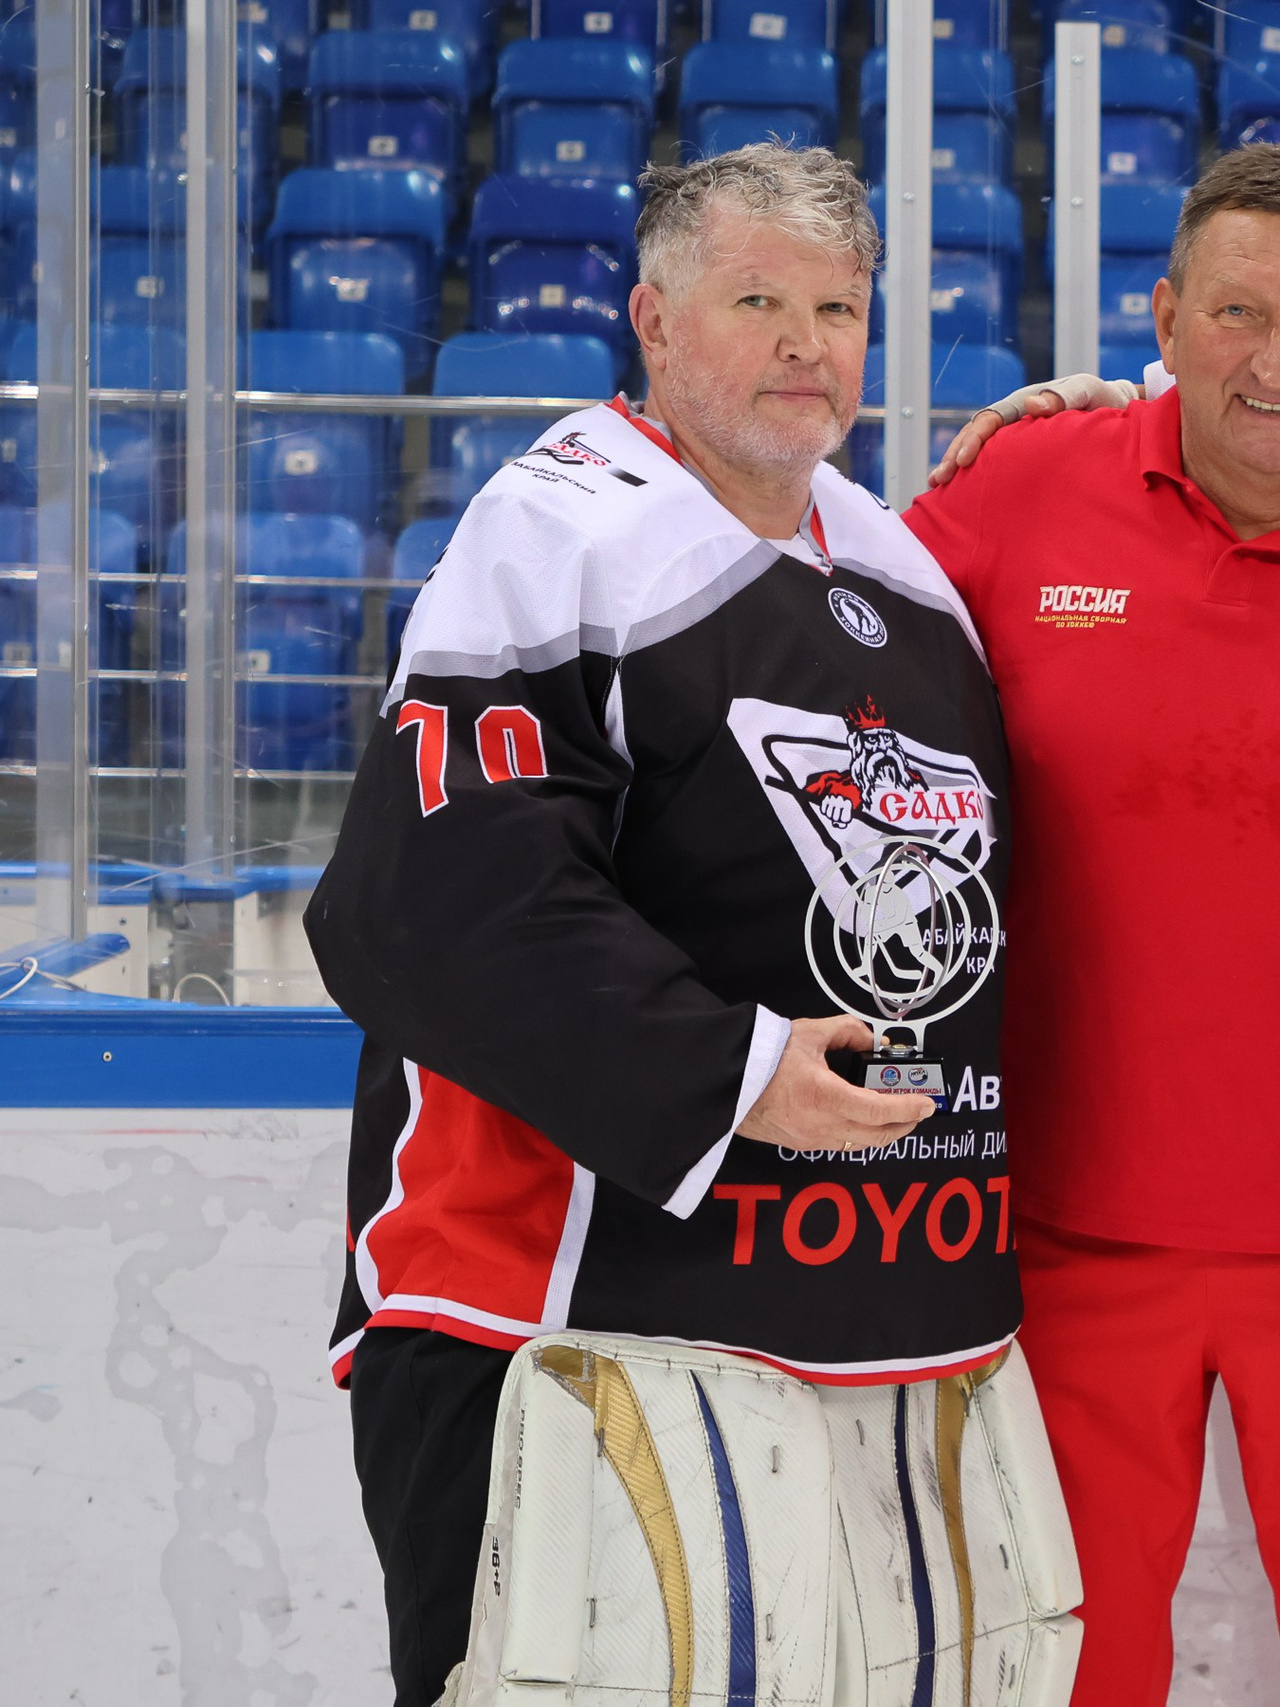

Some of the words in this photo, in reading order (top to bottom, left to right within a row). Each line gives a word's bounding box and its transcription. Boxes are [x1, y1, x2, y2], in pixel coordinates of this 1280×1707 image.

[1039, 585, 1131, 614] РОССИЯ
[396, 699, 550, 818] 70
[713, 1175, 1016, 1266] TOYOT
